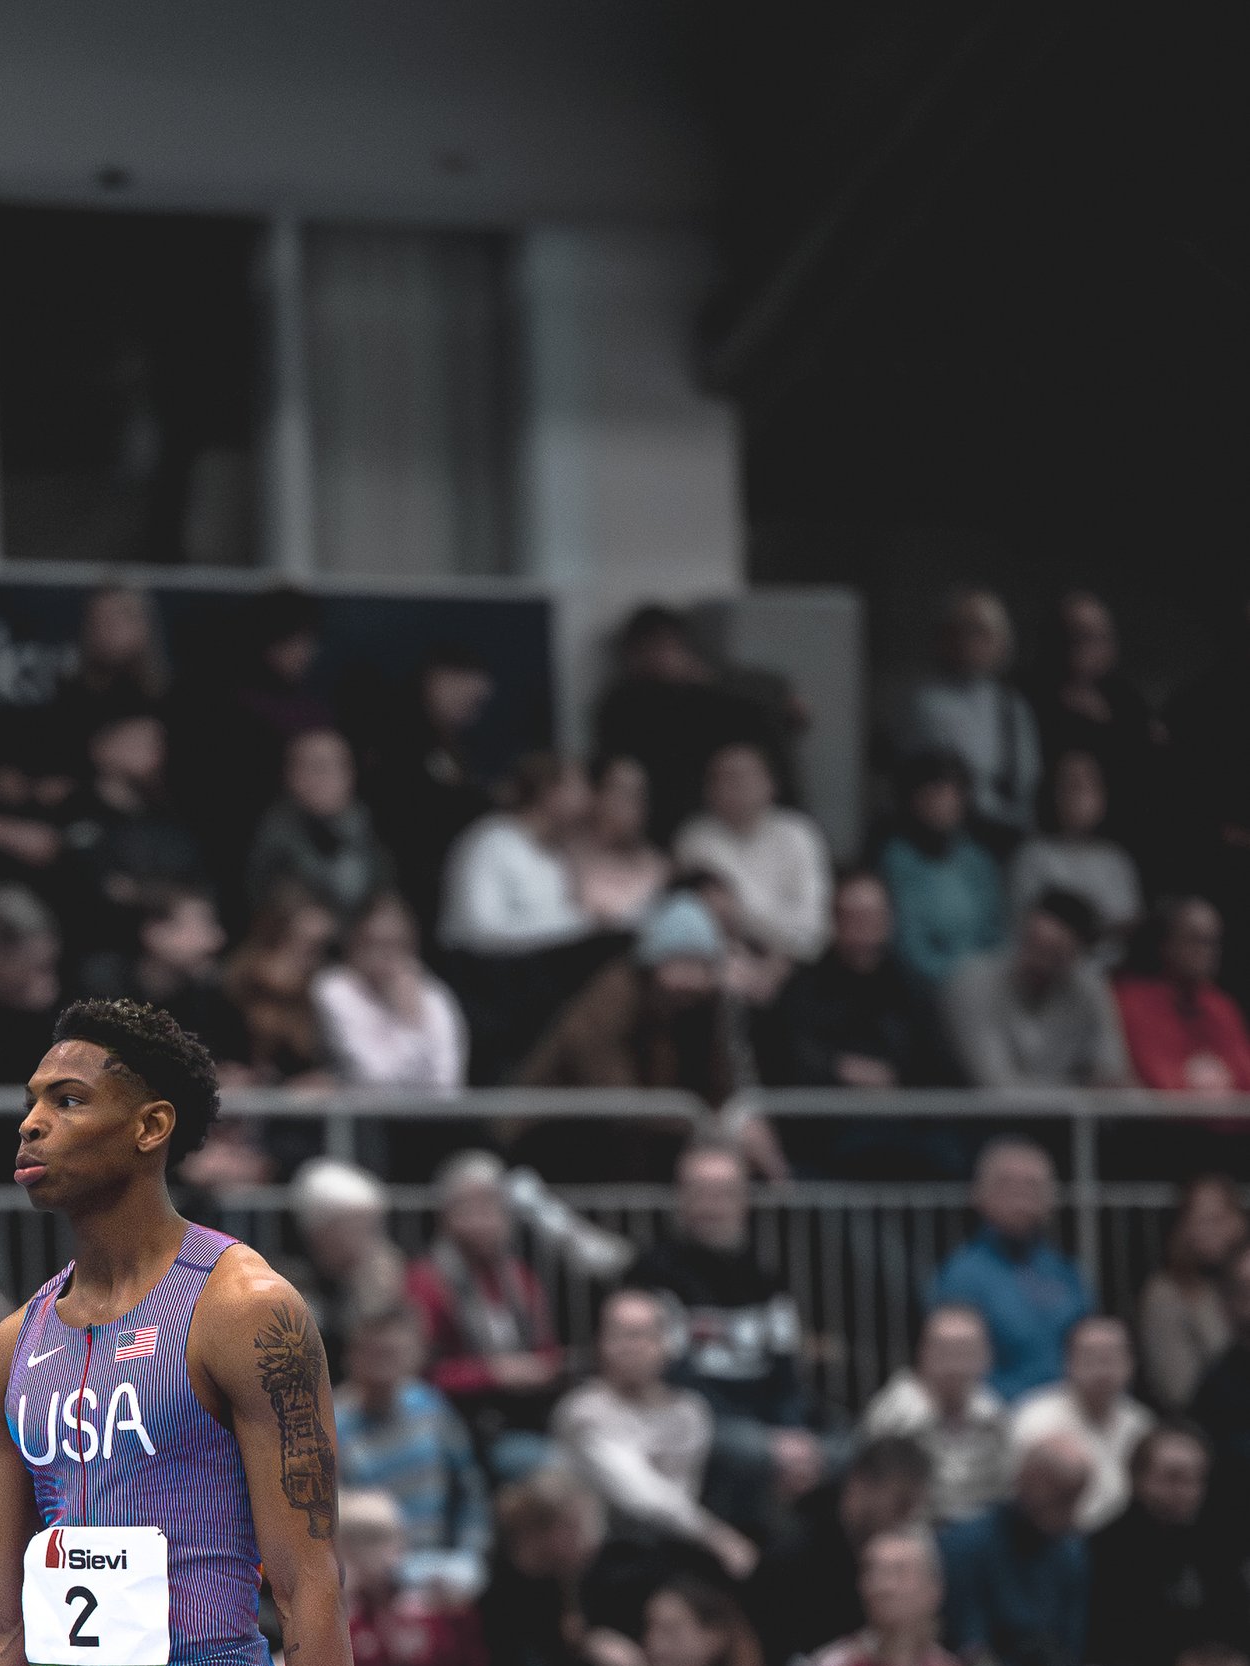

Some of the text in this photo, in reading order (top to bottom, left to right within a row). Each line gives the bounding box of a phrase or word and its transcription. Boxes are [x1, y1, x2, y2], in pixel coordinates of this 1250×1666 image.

[18, 1382, 156, 1466] USA
[68, 1549, 127, 1570] Sievi
[65, 1586, 100, 1647] 2
